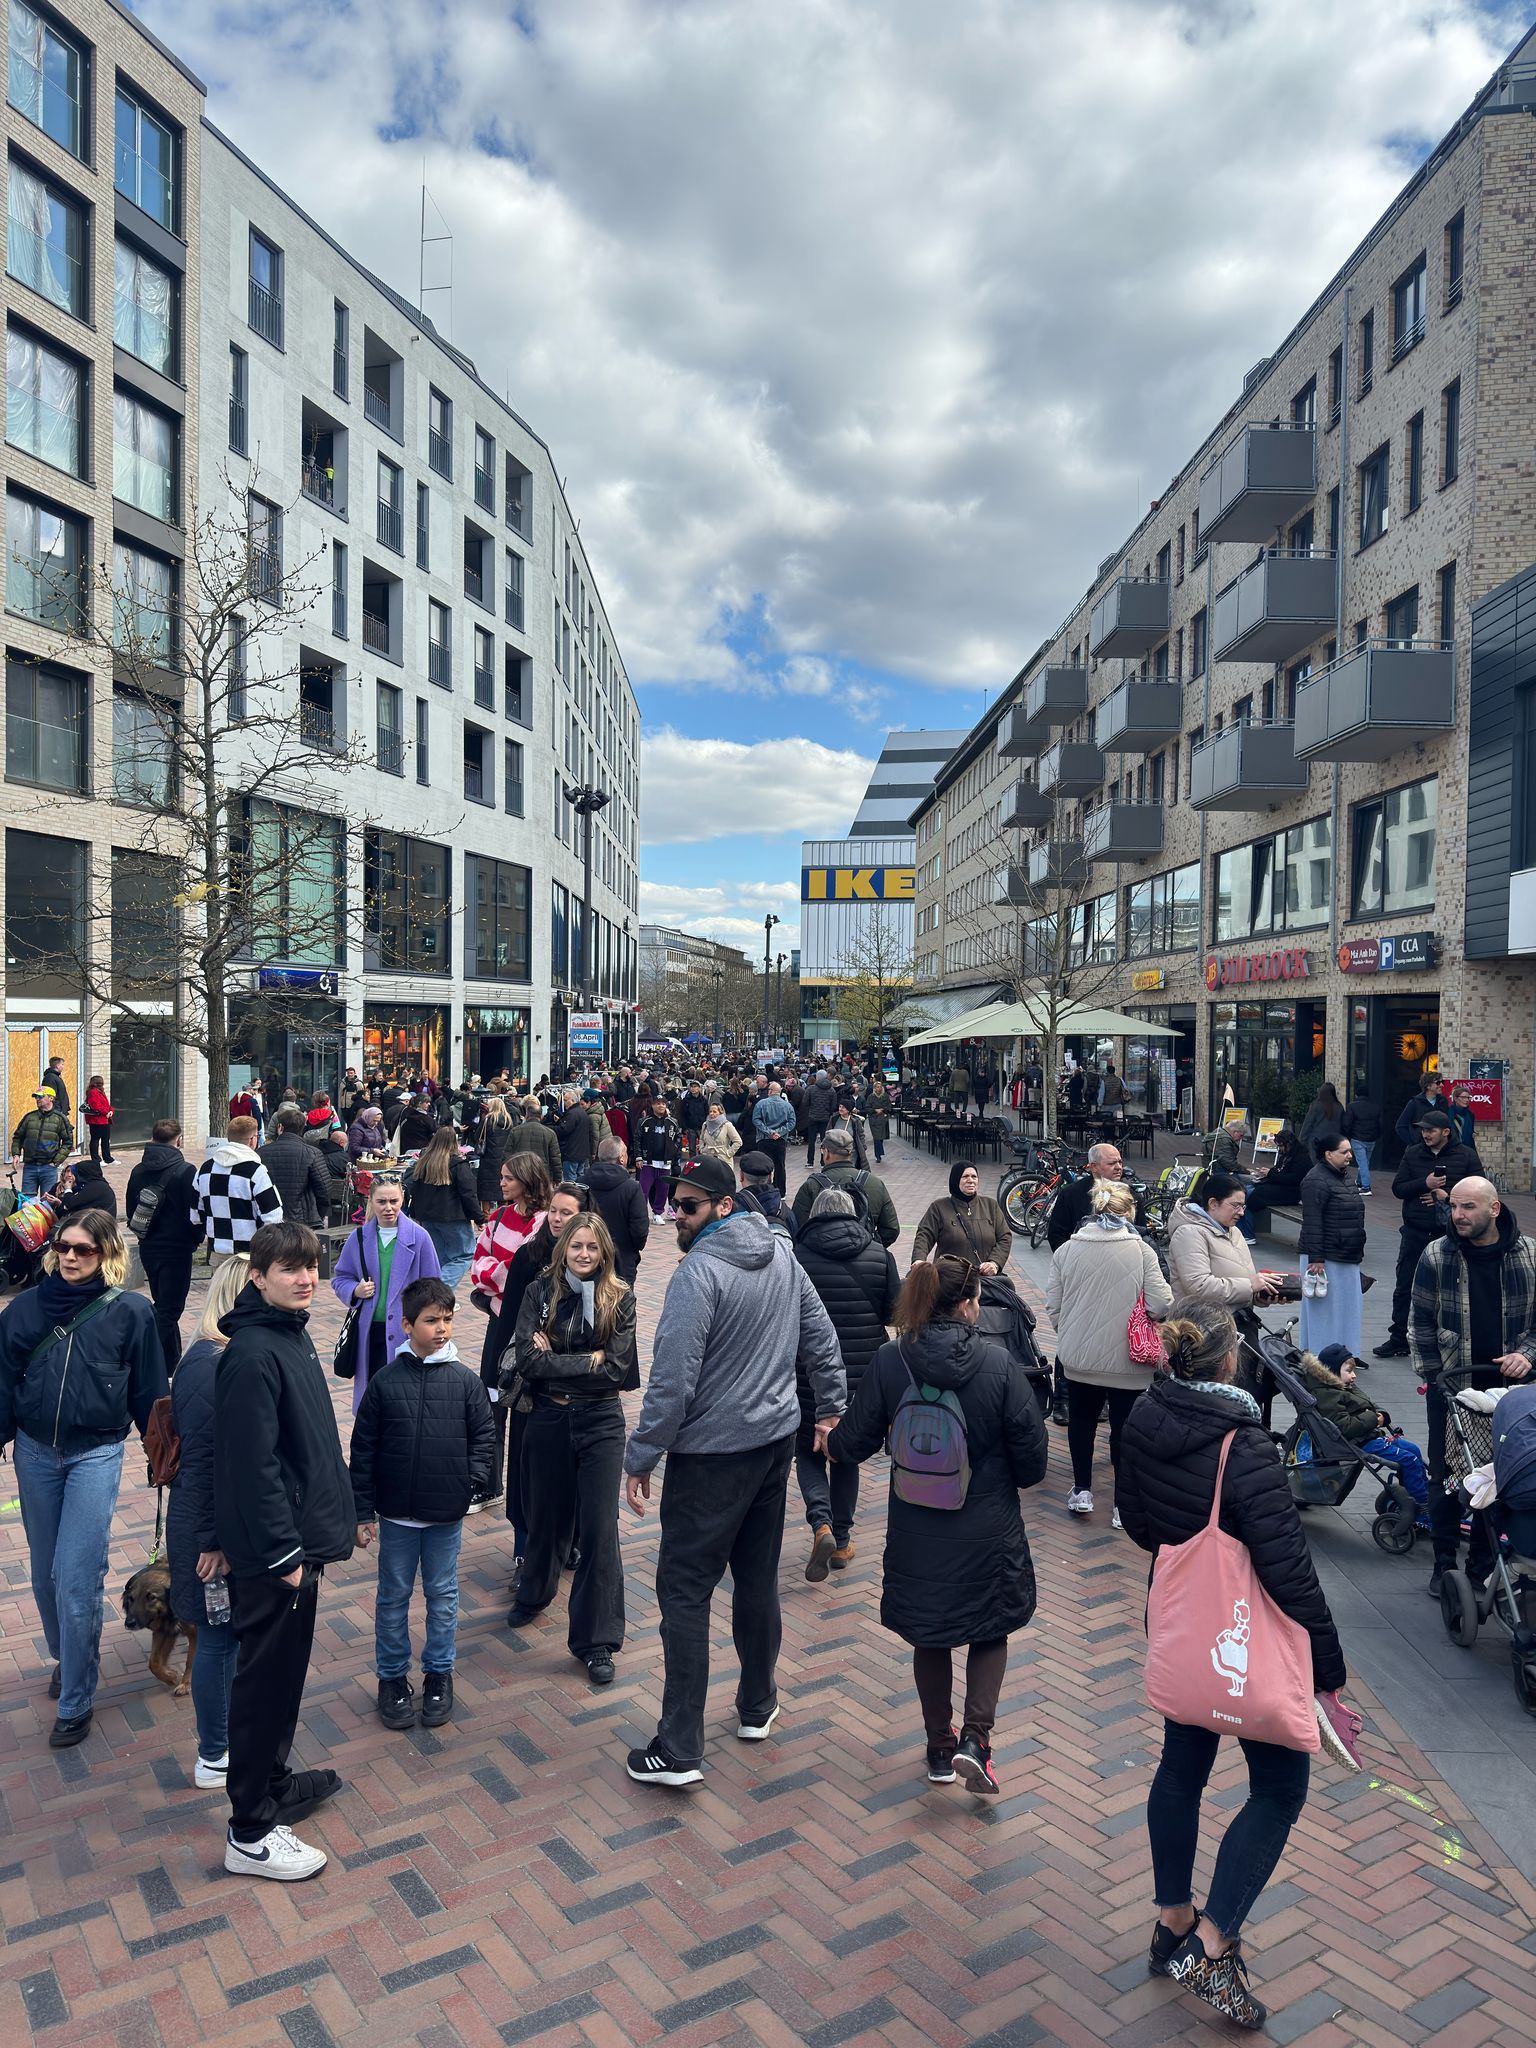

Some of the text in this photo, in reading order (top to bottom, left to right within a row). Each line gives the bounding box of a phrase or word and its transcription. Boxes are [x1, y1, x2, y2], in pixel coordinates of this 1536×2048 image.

[808, 869, 915, 898] IKE
[1368, 948, 1378, 957] Dao
[1382, 942, 1392, 966] P
[1401, 938, 1419, 953] CCA
[1221, 948, 1307, 985] JIM BLOCK
[1212, 1709, 1242, 1724] Irma
